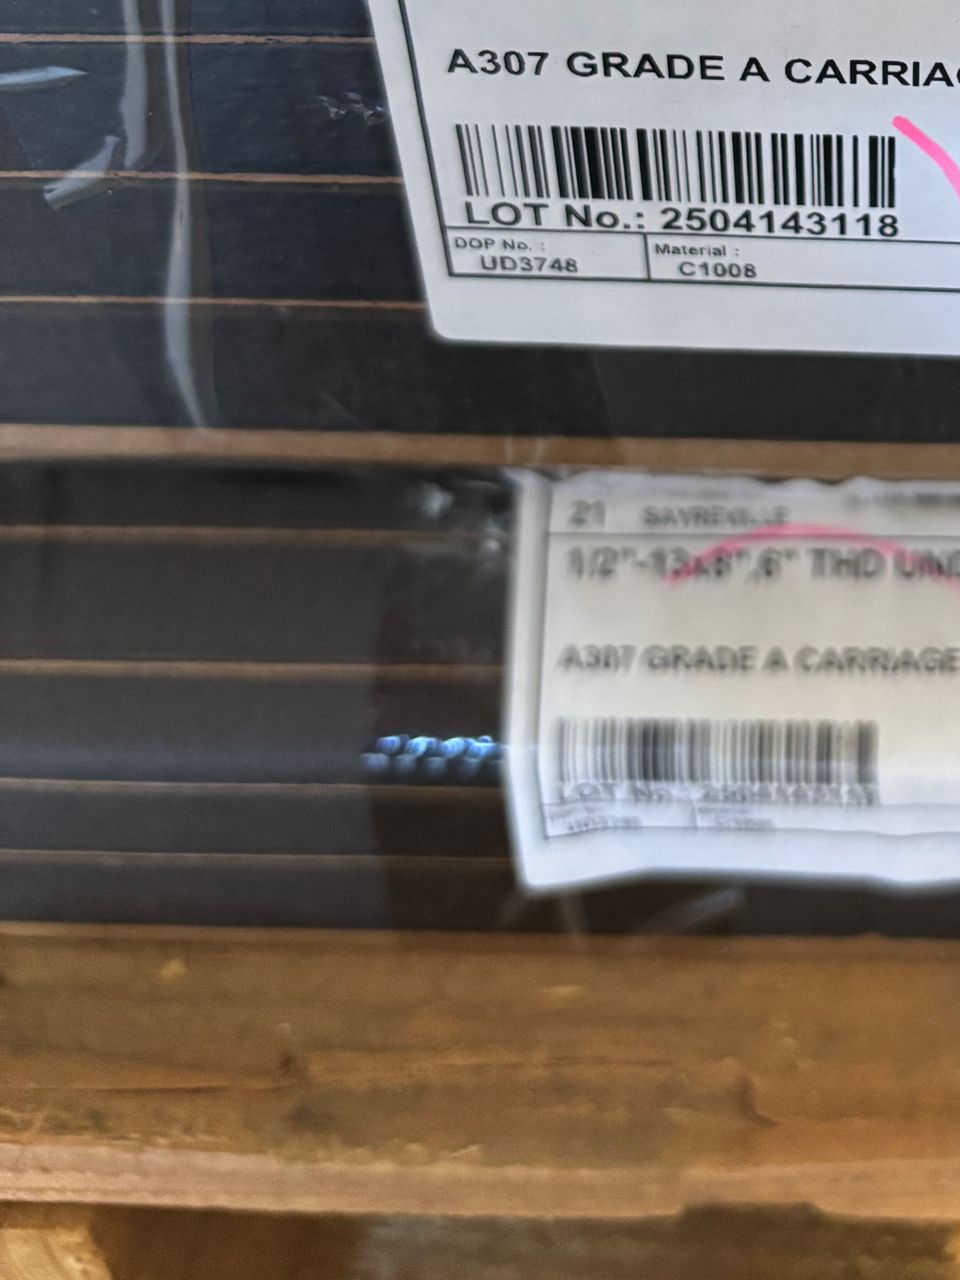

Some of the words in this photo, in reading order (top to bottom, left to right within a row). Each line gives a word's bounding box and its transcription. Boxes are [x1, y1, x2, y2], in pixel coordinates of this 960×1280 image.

[447, 48, 550, 76] A307
[566, 52, 725, 81] GRADE
[739, 57, 770, 82] A
[464, 201, 550, 228] LOT
[565, 204, 646, 231] No.:
[660, 206, 900, 239] 2504143118
[454, 236, 495, 251] DOP
[654, 243, 727, 257] Material
[480, 255, 579, 274] UD3748
[678, 260, 757, 279] C1008
[807, 548, 888, 580] THD
[642, 645, 757, 674] GRADE
[761, 646, 789, 674] A
